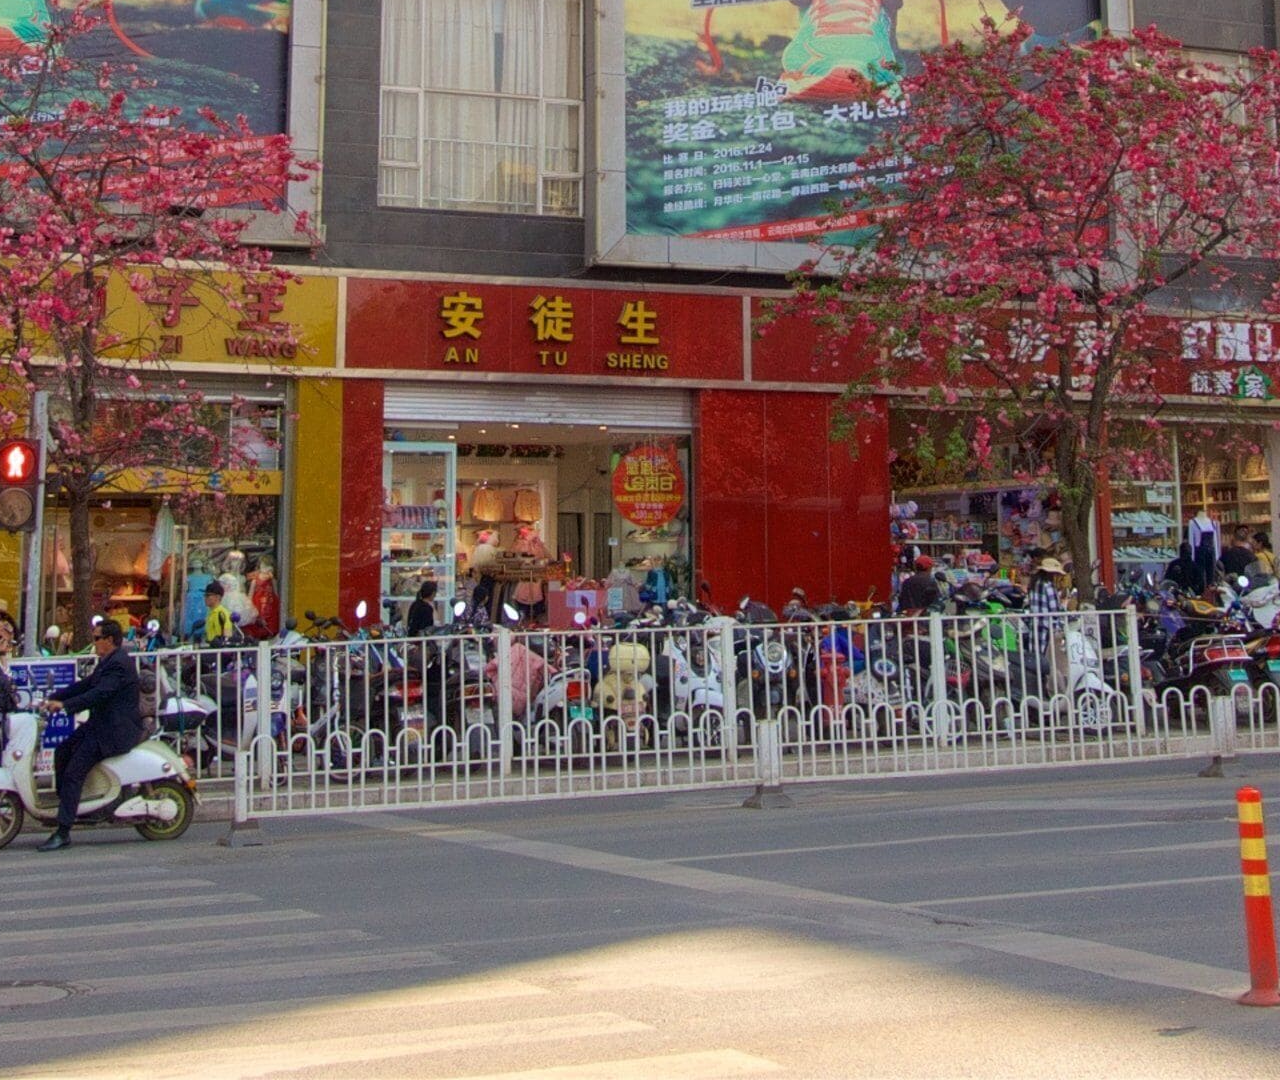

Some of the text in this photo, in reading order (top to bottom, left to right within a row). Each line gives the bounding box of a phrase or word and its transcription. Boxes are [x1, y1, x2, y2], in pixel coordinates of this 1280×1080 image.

[712, 142, 773, 160] 2016.12.24
[440, 291, 662, 346] 安徒生
[158, 334, 299, 359] ZI WANG
[443, 347, 670, 371] AN TU SHENG
